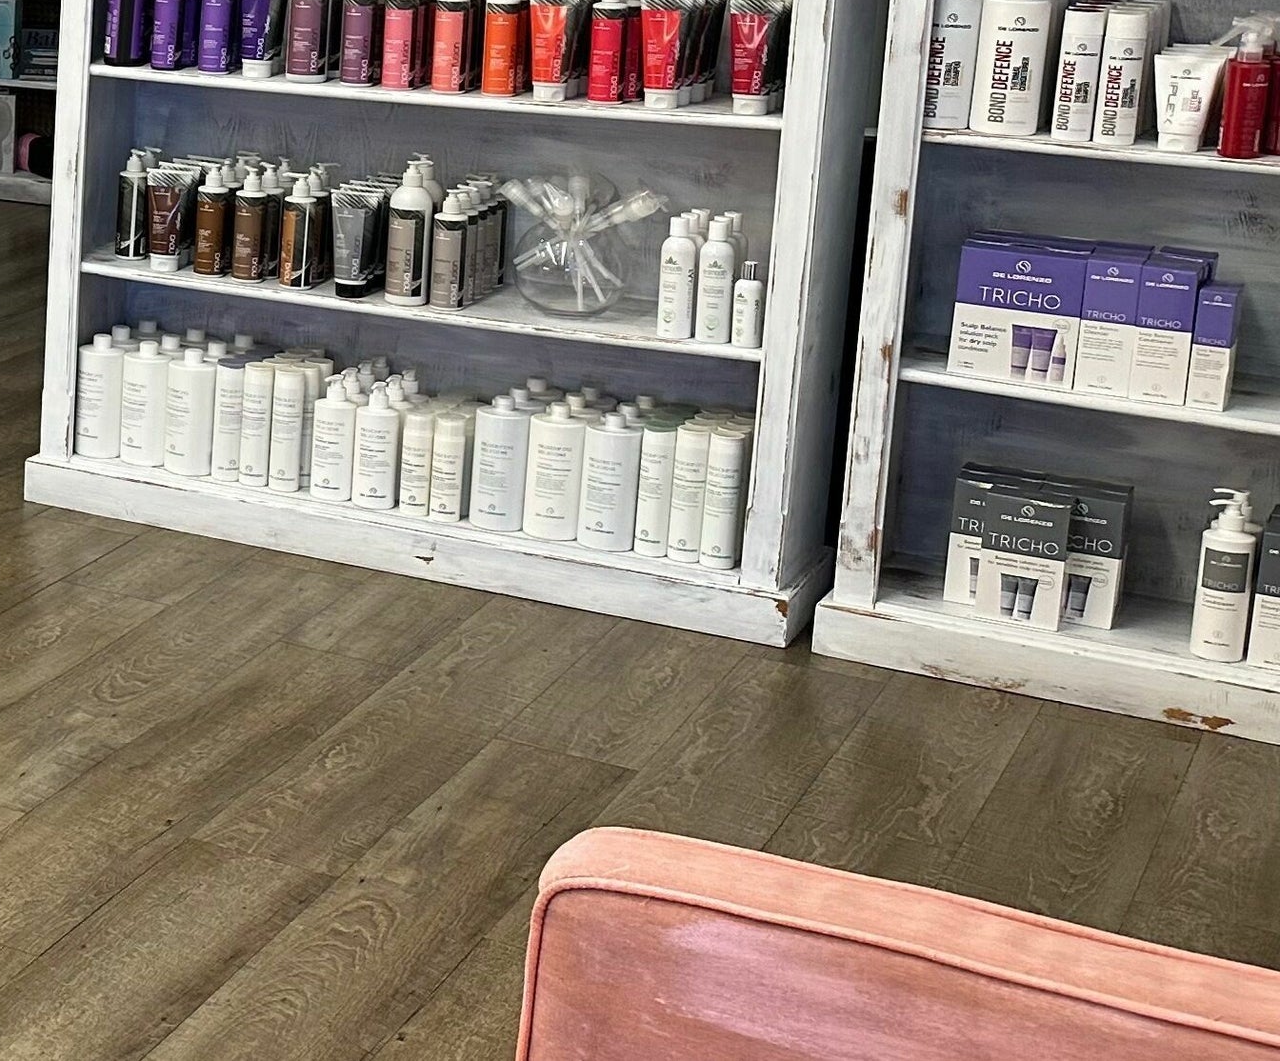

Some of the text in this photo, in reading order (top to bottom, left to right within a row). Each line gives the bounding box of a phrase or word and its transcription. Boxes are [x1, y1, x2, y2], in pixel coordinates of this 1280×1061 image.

[924, 36, 946, 119] BOND DEFENCE
[988, 40, 1013, 123] BOND DEFENCE
[1055, 59, 1077, 131] BOND DEFENCE
[1101, 64, 1123, 137] BOND DEFENCE
[992, 271, 1052, 284] DE LORENZO
[979, 285, 1061, 310] TRICHO
[1085, 309, 1127, 323] TRICHO
[1140, 316, 1182, 330] TRICHO
[958, 517, 986, 534] TRI
[1013, 516, 1054, 528] LORENZO
[989, 532, 1060, 556] TRICHO
